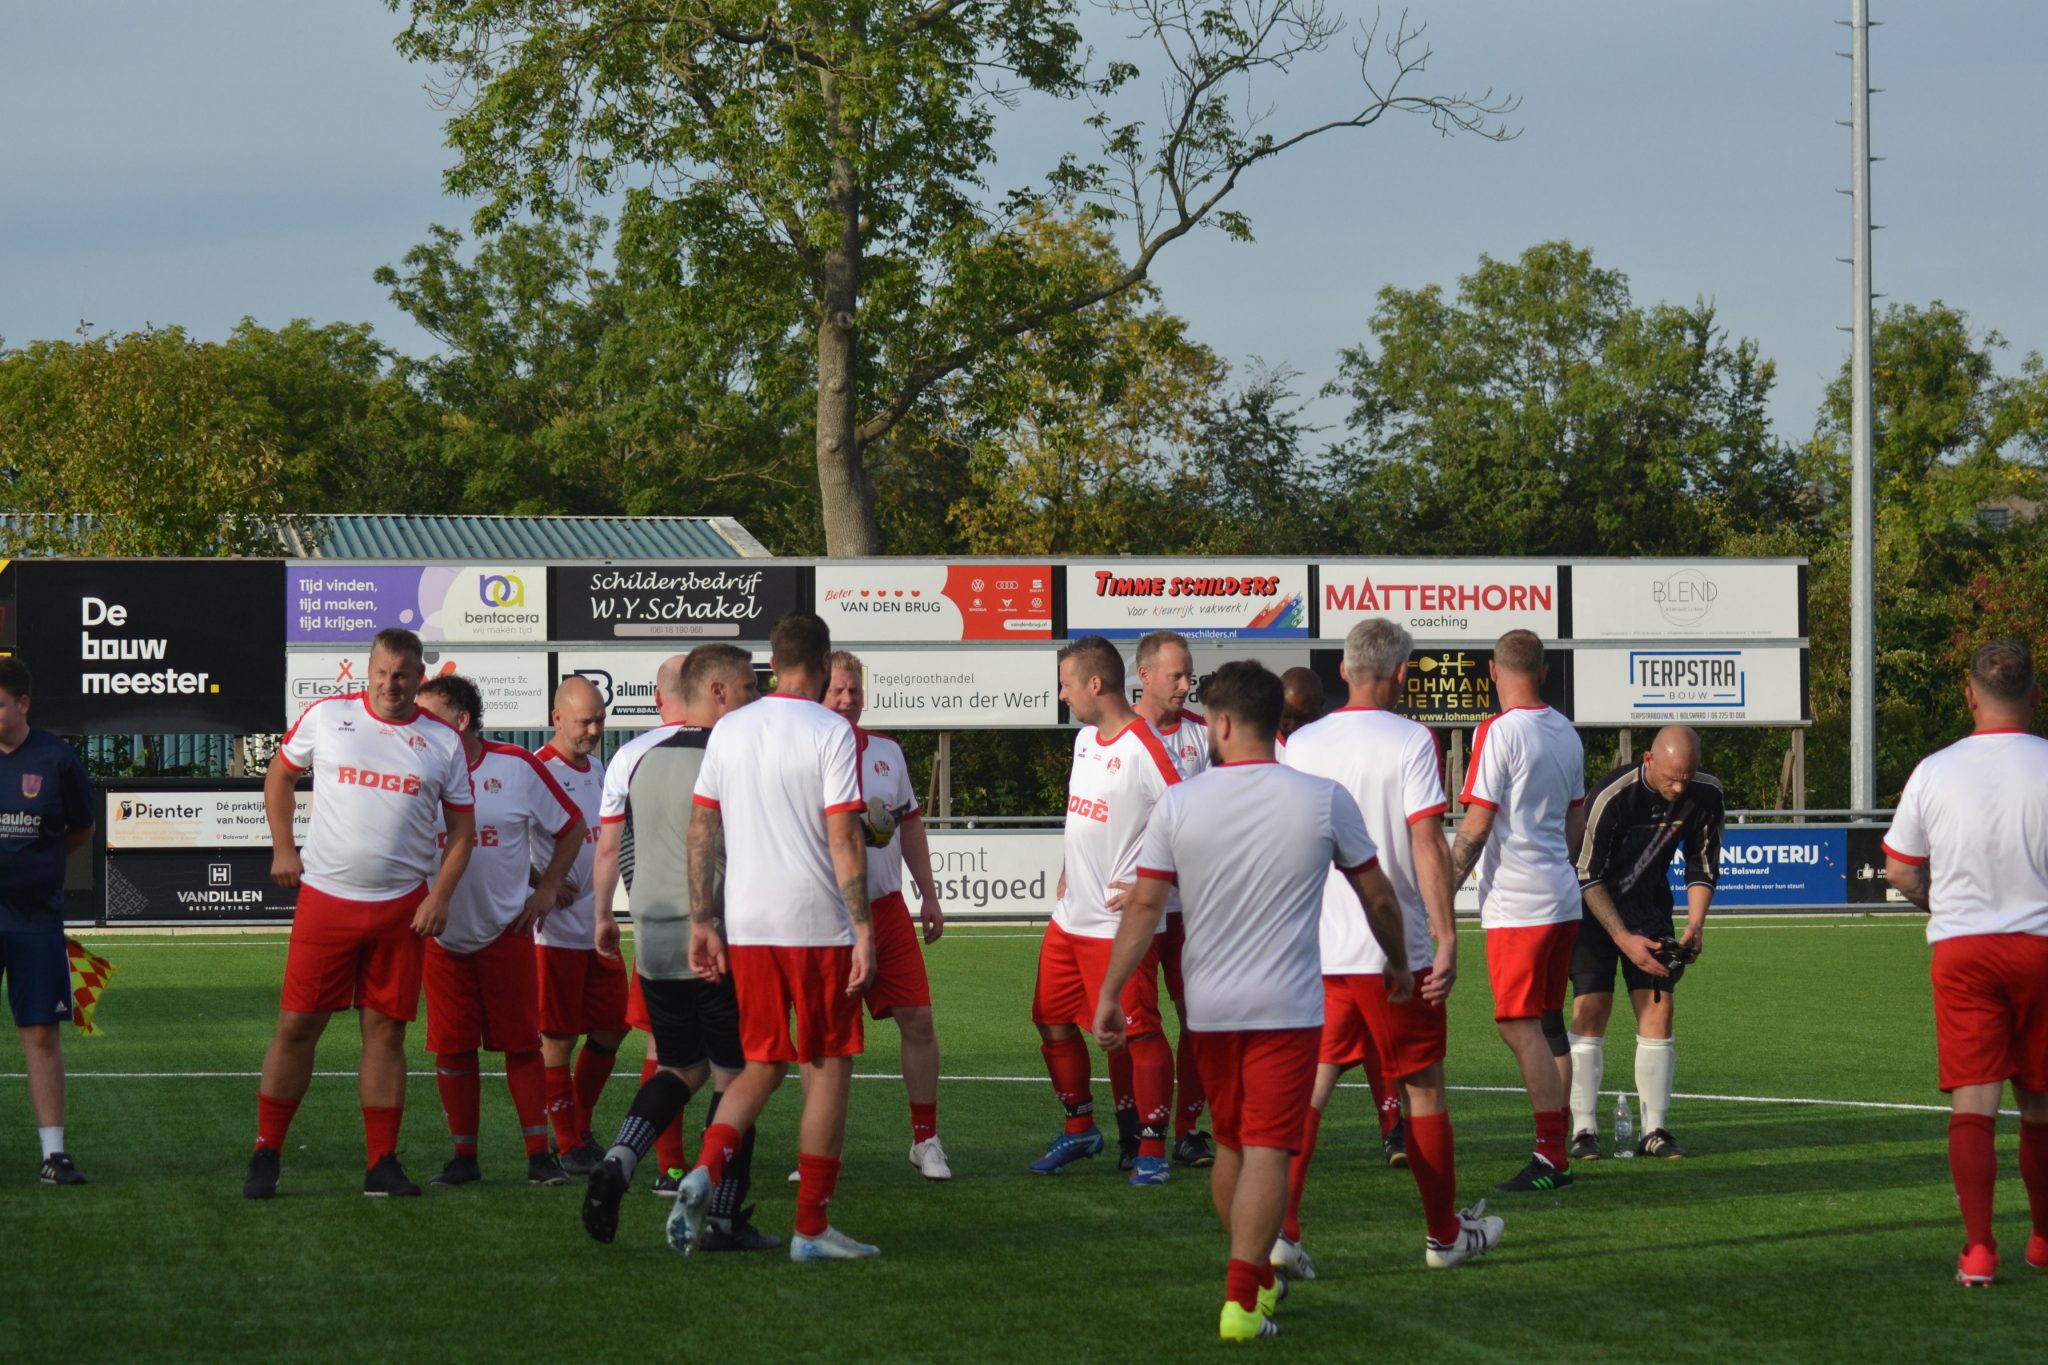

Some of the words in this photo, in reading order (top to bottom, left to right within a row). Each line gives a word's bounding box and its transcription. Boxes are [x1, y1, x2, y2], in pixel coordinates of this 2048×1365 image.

[299, 579, 323, 594] Tijd
[326, 579, 378, 593] vinden,
[590, 571, 762, 596] Schildersbedrijf
[1095, 571, 1165, 596] TIMME
[1168, 575, 1280, 597] SCHILDERS
[825, 588, 854, 602] Beter
[1326, 576, 1552, 611] MATTERHORN
[1653, 580, 1718, 602] BLEND
[82, 597, 128, 627] De
[299, 598, 321, 613] tijd
[325, 598, 378, 612] maken,
[841, 602, 868, 613] VAN
[873, 602, 901, 613] DEN
[905, 602, 941, 613] BRUG
[1127, 606, 1147, 617] Voor
[1152, 605, 1194, 619] kleurrijk
[299, 616, 321, 631] tijd
[325, 616, 377, 632] krijgen.
[465, 611, 540, 624] bentacera
[1410, 616, 1468, 630] coaching
[491, 625, 516, 635] maken
[518, 625, 534, 635] tijd
[1010, 621, 1048, 629] vandenbrug.nl
[82, 630, 168, 660] bouw
[873, 673, 975, 685] Tegelgroothandel
[1639, 660, 1737, 687] TERPSTRA
[82, 667, 220, 695] meester.
[479, 676, 516, 687] Wymerts
[518, 676, 529, 685] 2c
[1402, 677, 1490, 693] OHMAN
[487, 688, 501, 697] WT
[504, 687, 542, 697] Bolsward
[1669, 691, 1708, 700] BOUW
[484, 701, 519, 710] 3055502
[873, 691, 925, 709] Julius
[931, 694, 962, 709] van
[967, 691, 999, 709] der
[1004, 690, 1050, 709] Werf
[1397, 693, 1490, 709] FIETSEN
[1630, 711, 1675, 720] TERPSTRABOUW.NL
[1679, 711, 1707, 720] BOLSWARD
[135, 801, 204, 820] Pienter
[216, 801, 230, 812] Dé
[216, 816, 234, 826] van
[930, 847, 988, 873] omt
[1731, 866, 1770, 876] Bolsward
[1744, 883, 1761, 891] leden
[1761, 883, 1775, 891] voor
[1775, 882, 1787, 890] hun
[176, 890, 263, 904] VANDILLEN
